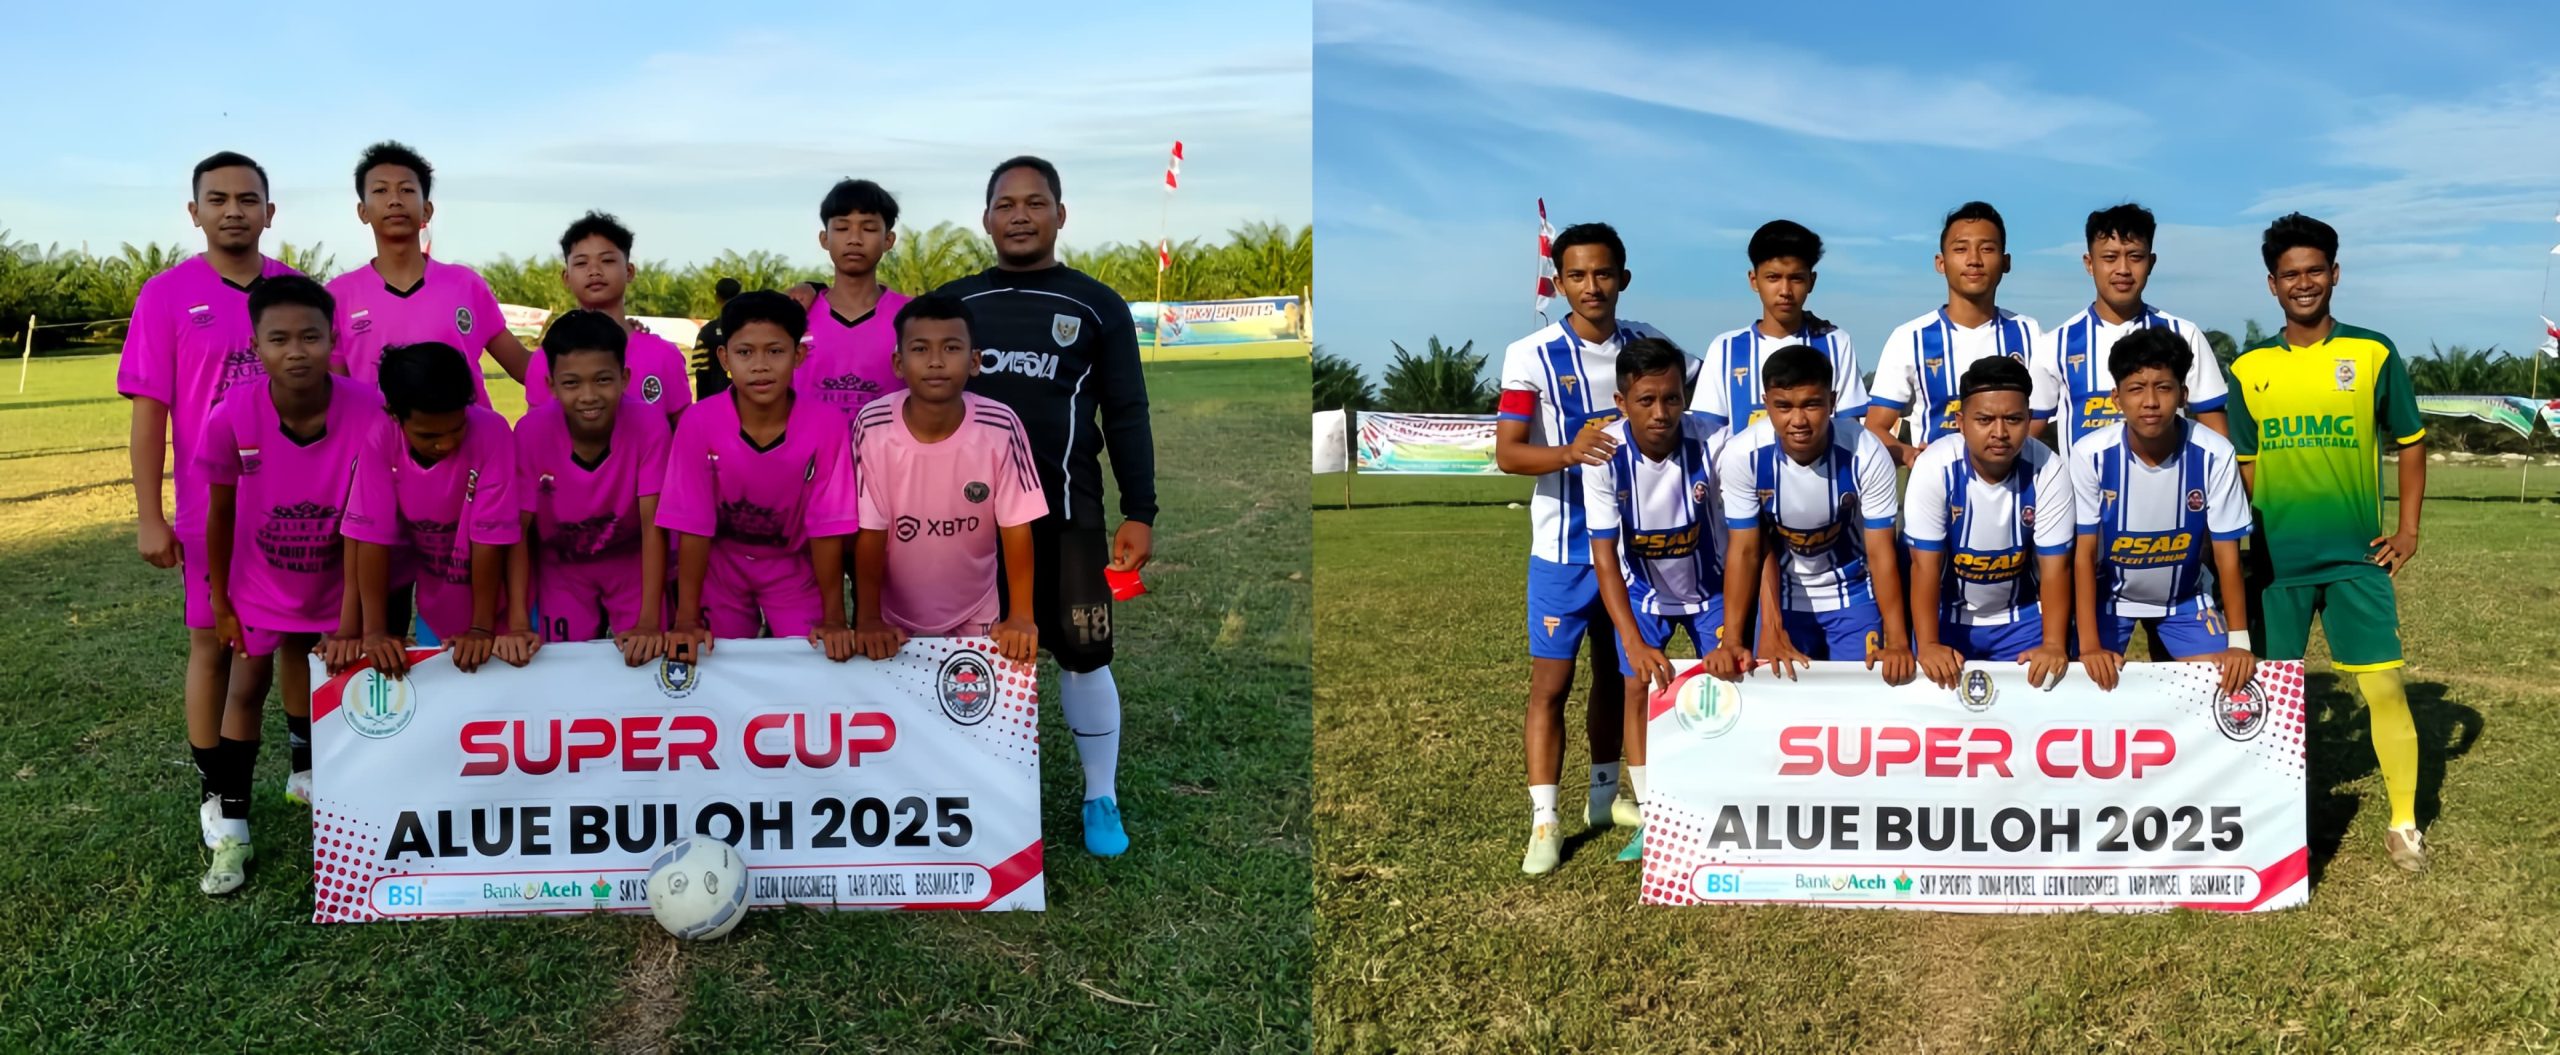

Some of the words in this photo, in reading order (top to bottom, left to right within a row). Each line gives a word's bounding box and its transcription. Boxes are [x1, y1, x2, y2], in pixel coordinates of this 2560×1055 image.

[2262, 414, 2355, 439] BUMG
[2111, 533, 2193, 555] PSAB
[459, 713, 720, 778] SUPER
[743, 711, 898, 769] CUP
[1777, 726, 2014, 778] SUPER
[2036, 728, 2177, 780] CUP
[384, 808, 553, 861] ALUE
[811, 796, 973, 850] 2025
[1707, 806, 1861, 851] ALUE
[1876, 805, 2086, 853] BULOH
[2096, 805, 2244, 853] 2025
[387, 884, 423, 906] BSI
[483, 882, 522, 899] Bank
[539, 881, 582, 898] Aceh
[1706, 873, 1741, 893] BSI
[1795, 873, 1831, 889] Bank
[1848, 874, 1886, 890] Aceh
[1939, 875, 1972, 895] SPORTS
